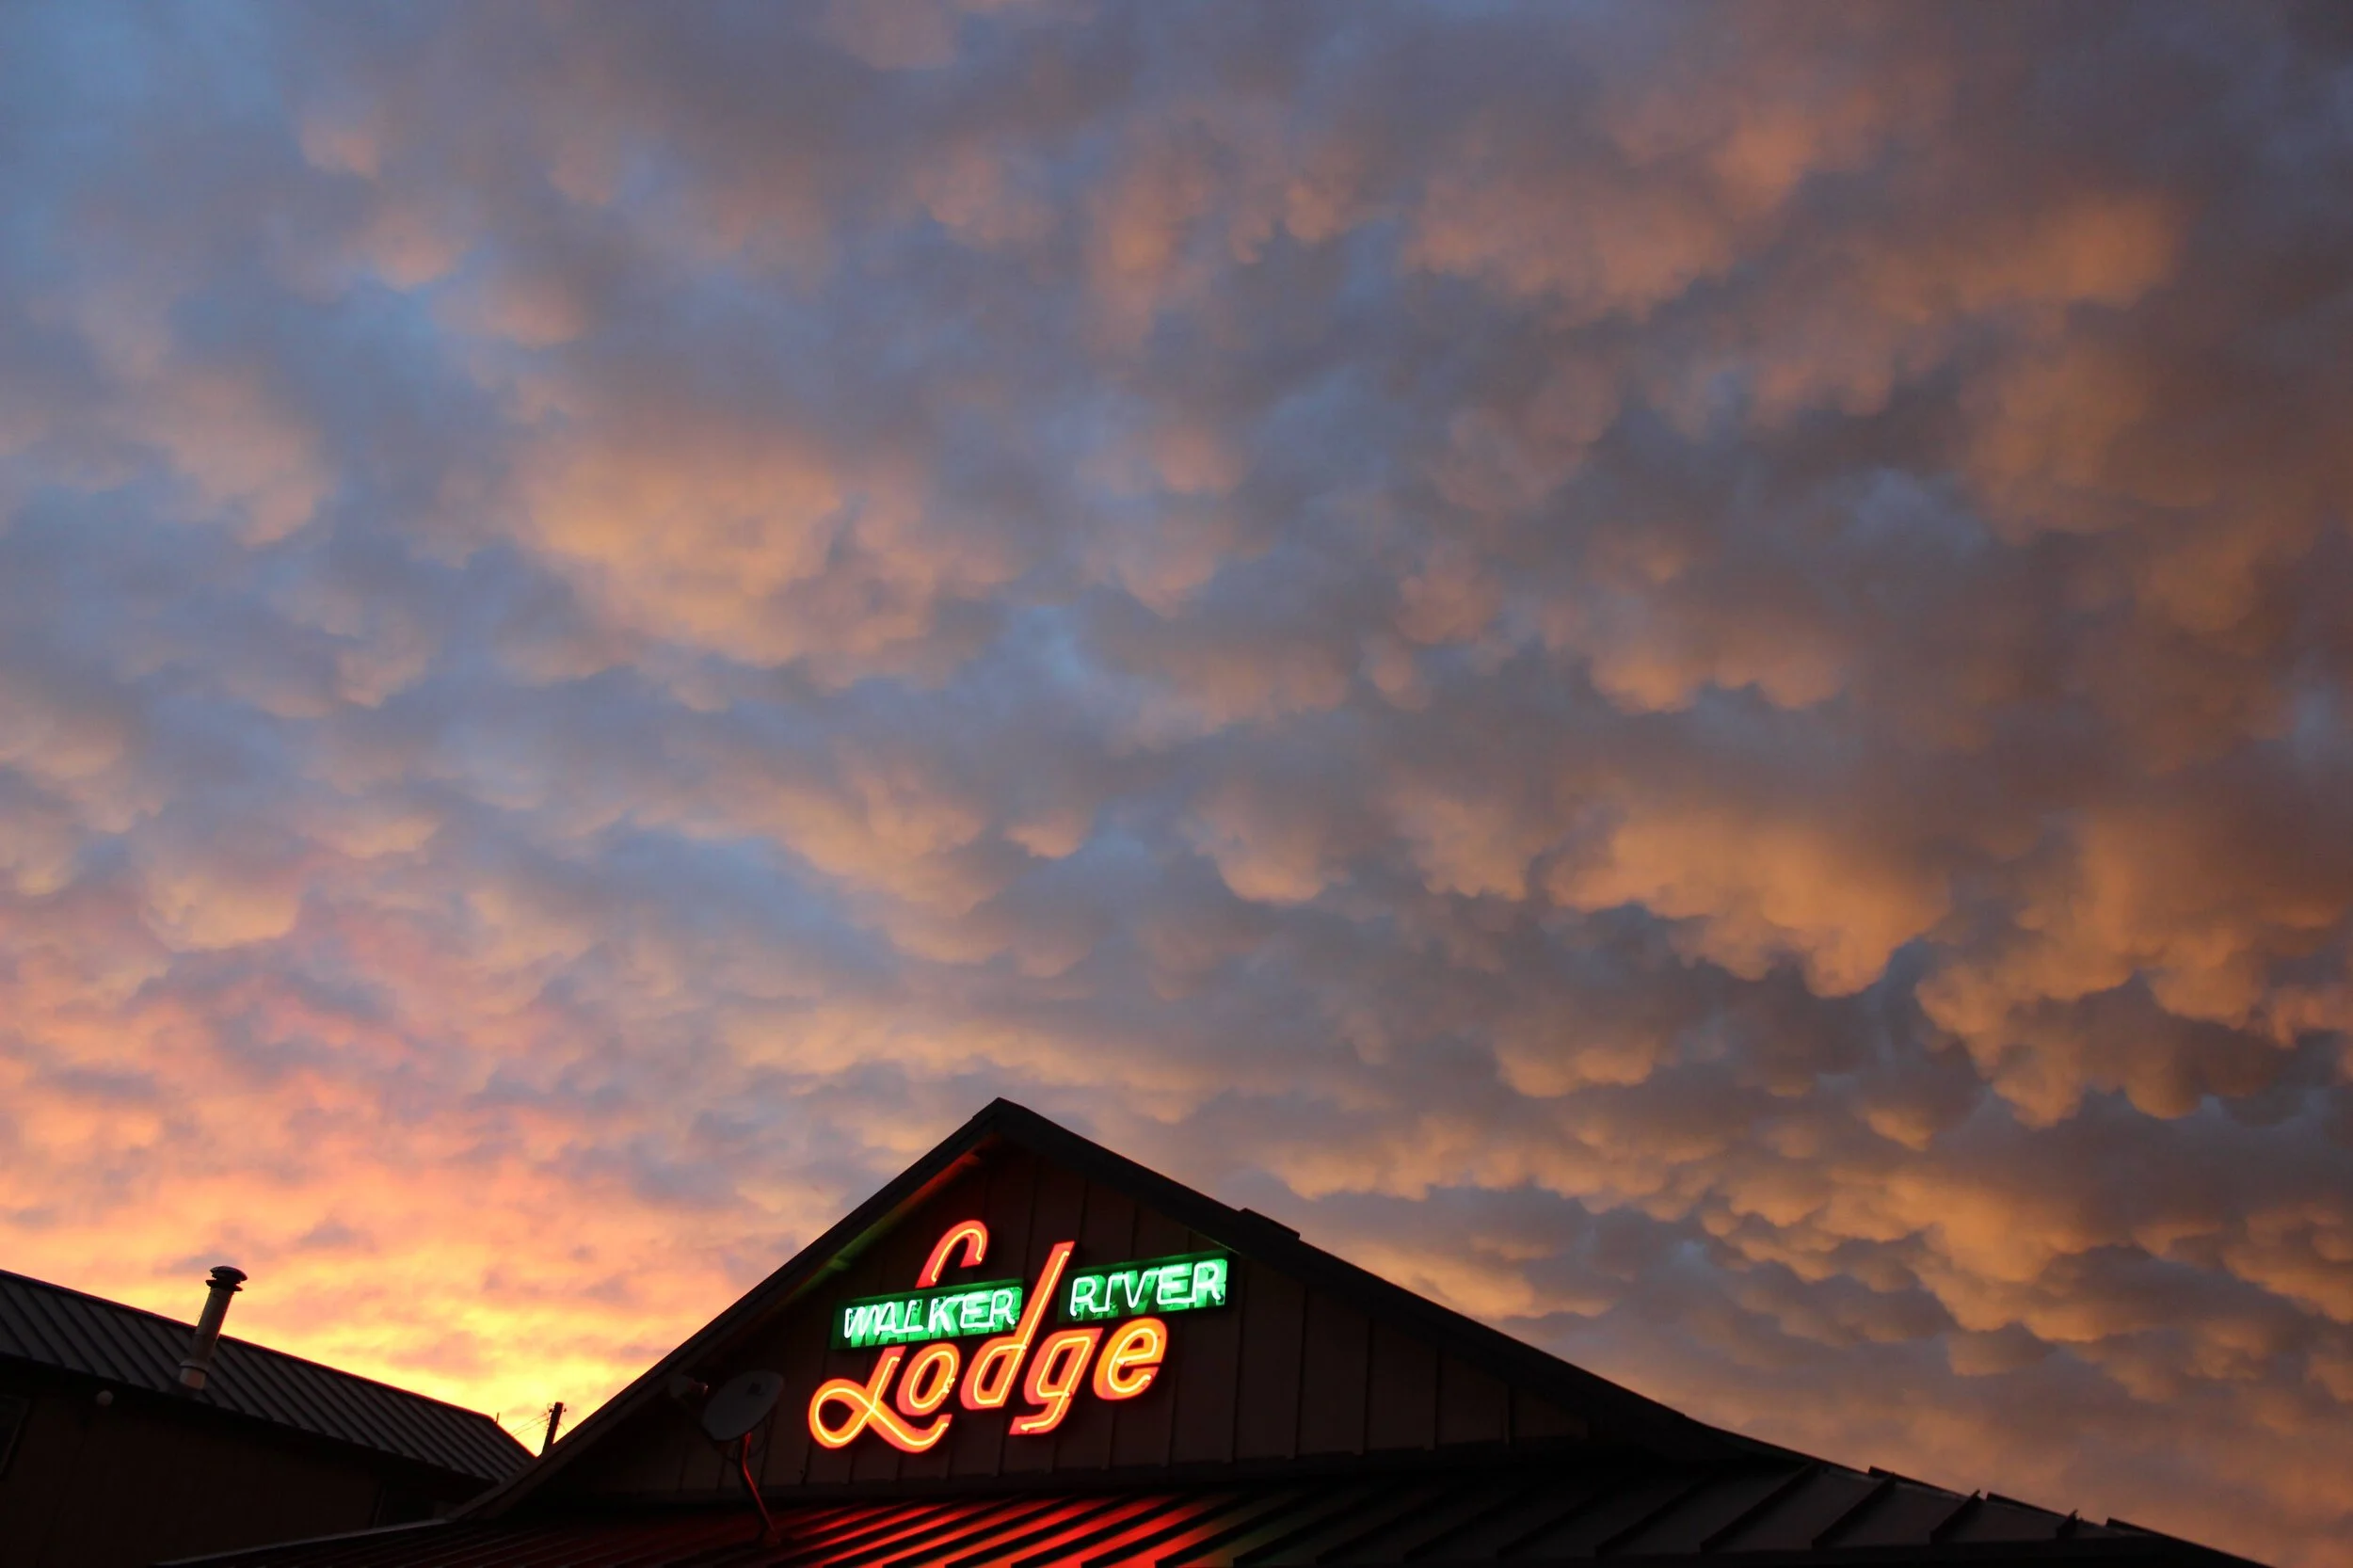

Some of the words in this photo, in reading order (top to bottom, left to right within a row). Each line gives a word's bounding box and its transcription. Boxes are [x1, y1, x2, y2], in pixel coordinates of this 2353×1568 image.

[808, 1221, 1167, 1452] Lodge
[843, 1288, 1022, 1347] WALKER
[1070, 1259, 1227, 1320] RIVER
